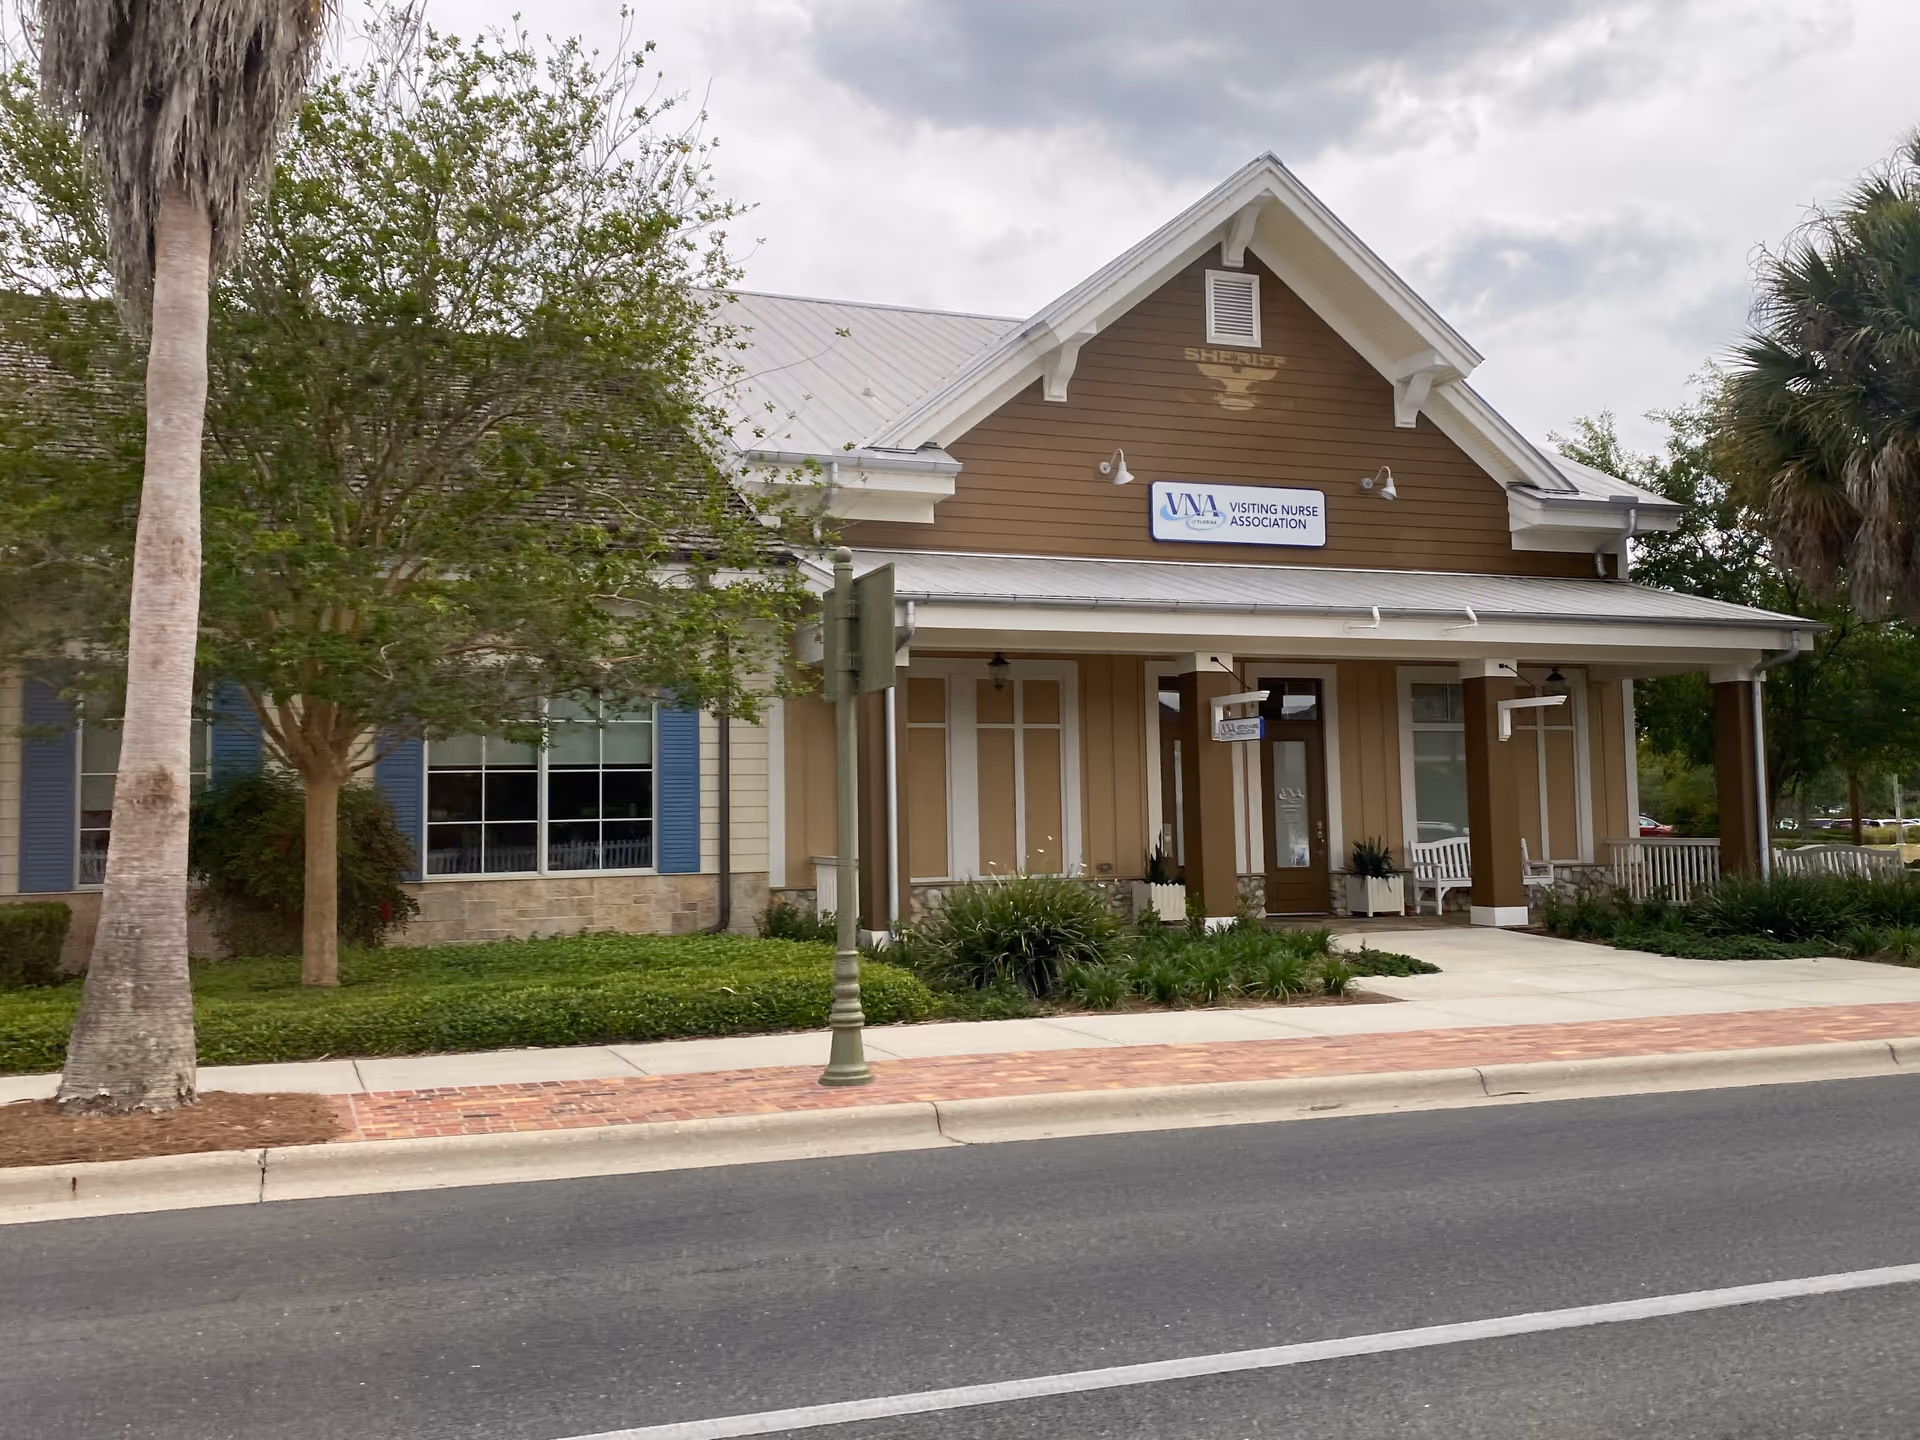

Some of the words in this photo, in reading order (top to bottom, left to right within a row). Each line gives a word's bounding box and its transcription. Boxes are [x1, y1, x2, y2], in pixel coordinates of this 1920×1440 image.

[1184, 347, 1287, 367] SHERIFF
[1165, 492, 1220, 517] VNA
[1230, 502, 1278, 515] VISITING
[1281, 505, 1318, 516] NURSE
[1230, 516, 1306, 529] ASSOCIATION
